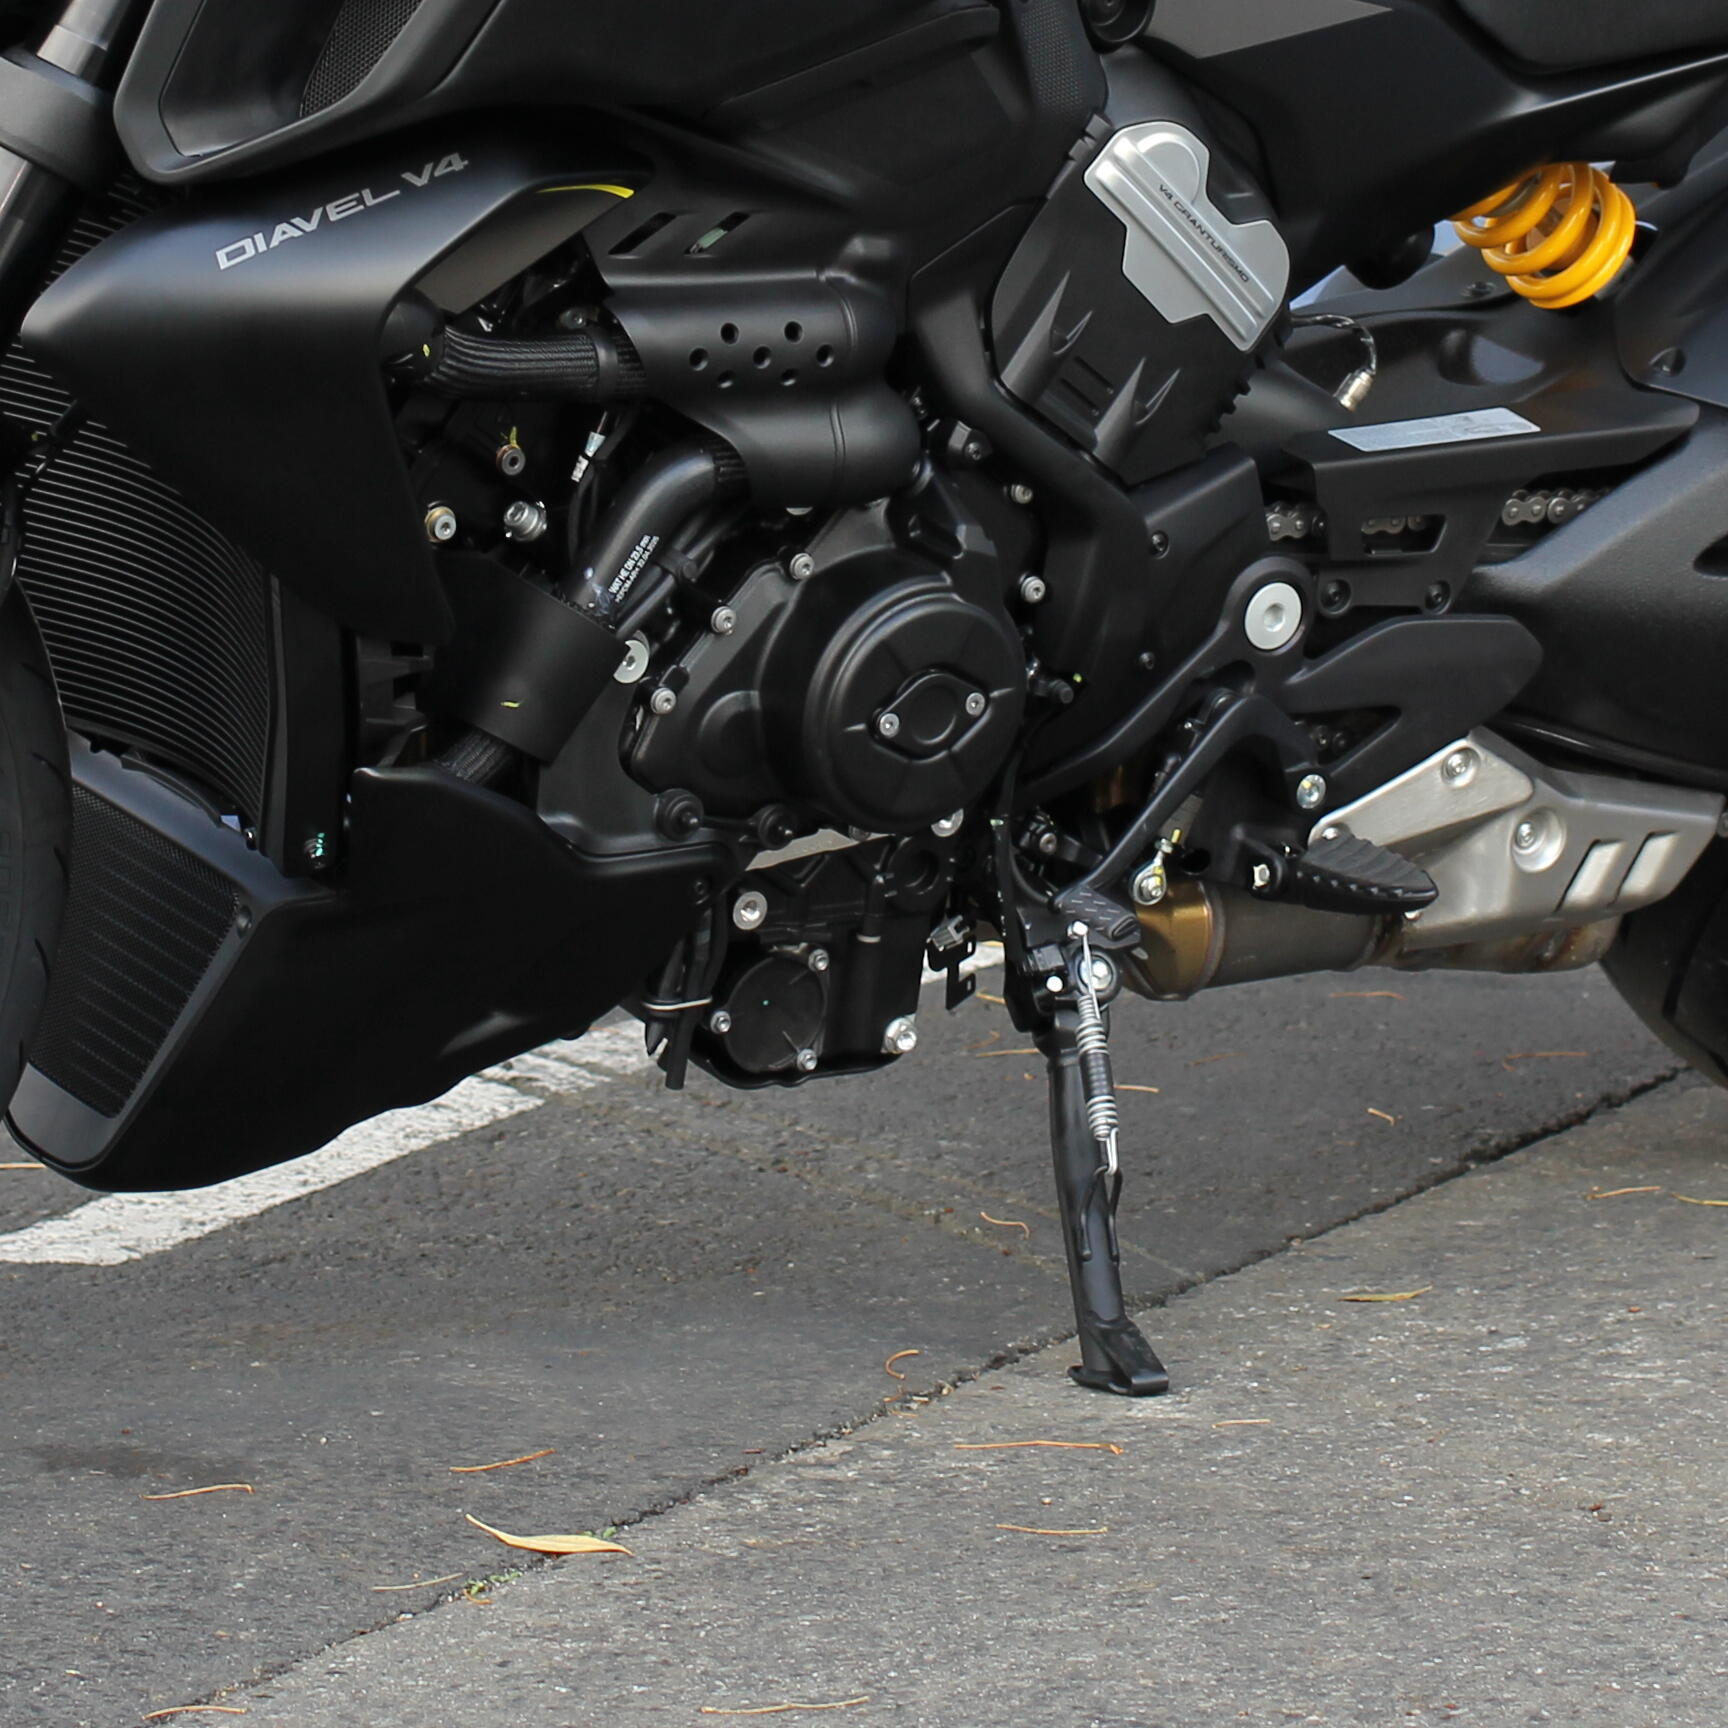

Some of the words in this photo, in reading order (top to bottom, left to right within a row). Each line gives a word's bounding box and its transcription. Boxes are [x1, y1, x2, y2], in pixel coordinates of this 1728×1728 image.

[215, 188, 401, 270] DIAVEL
[401, 152, 469, 187] V4
[1159, 184, 1174, 200] V4
[1174, 201, 1249, 282] GRANTURISMO
